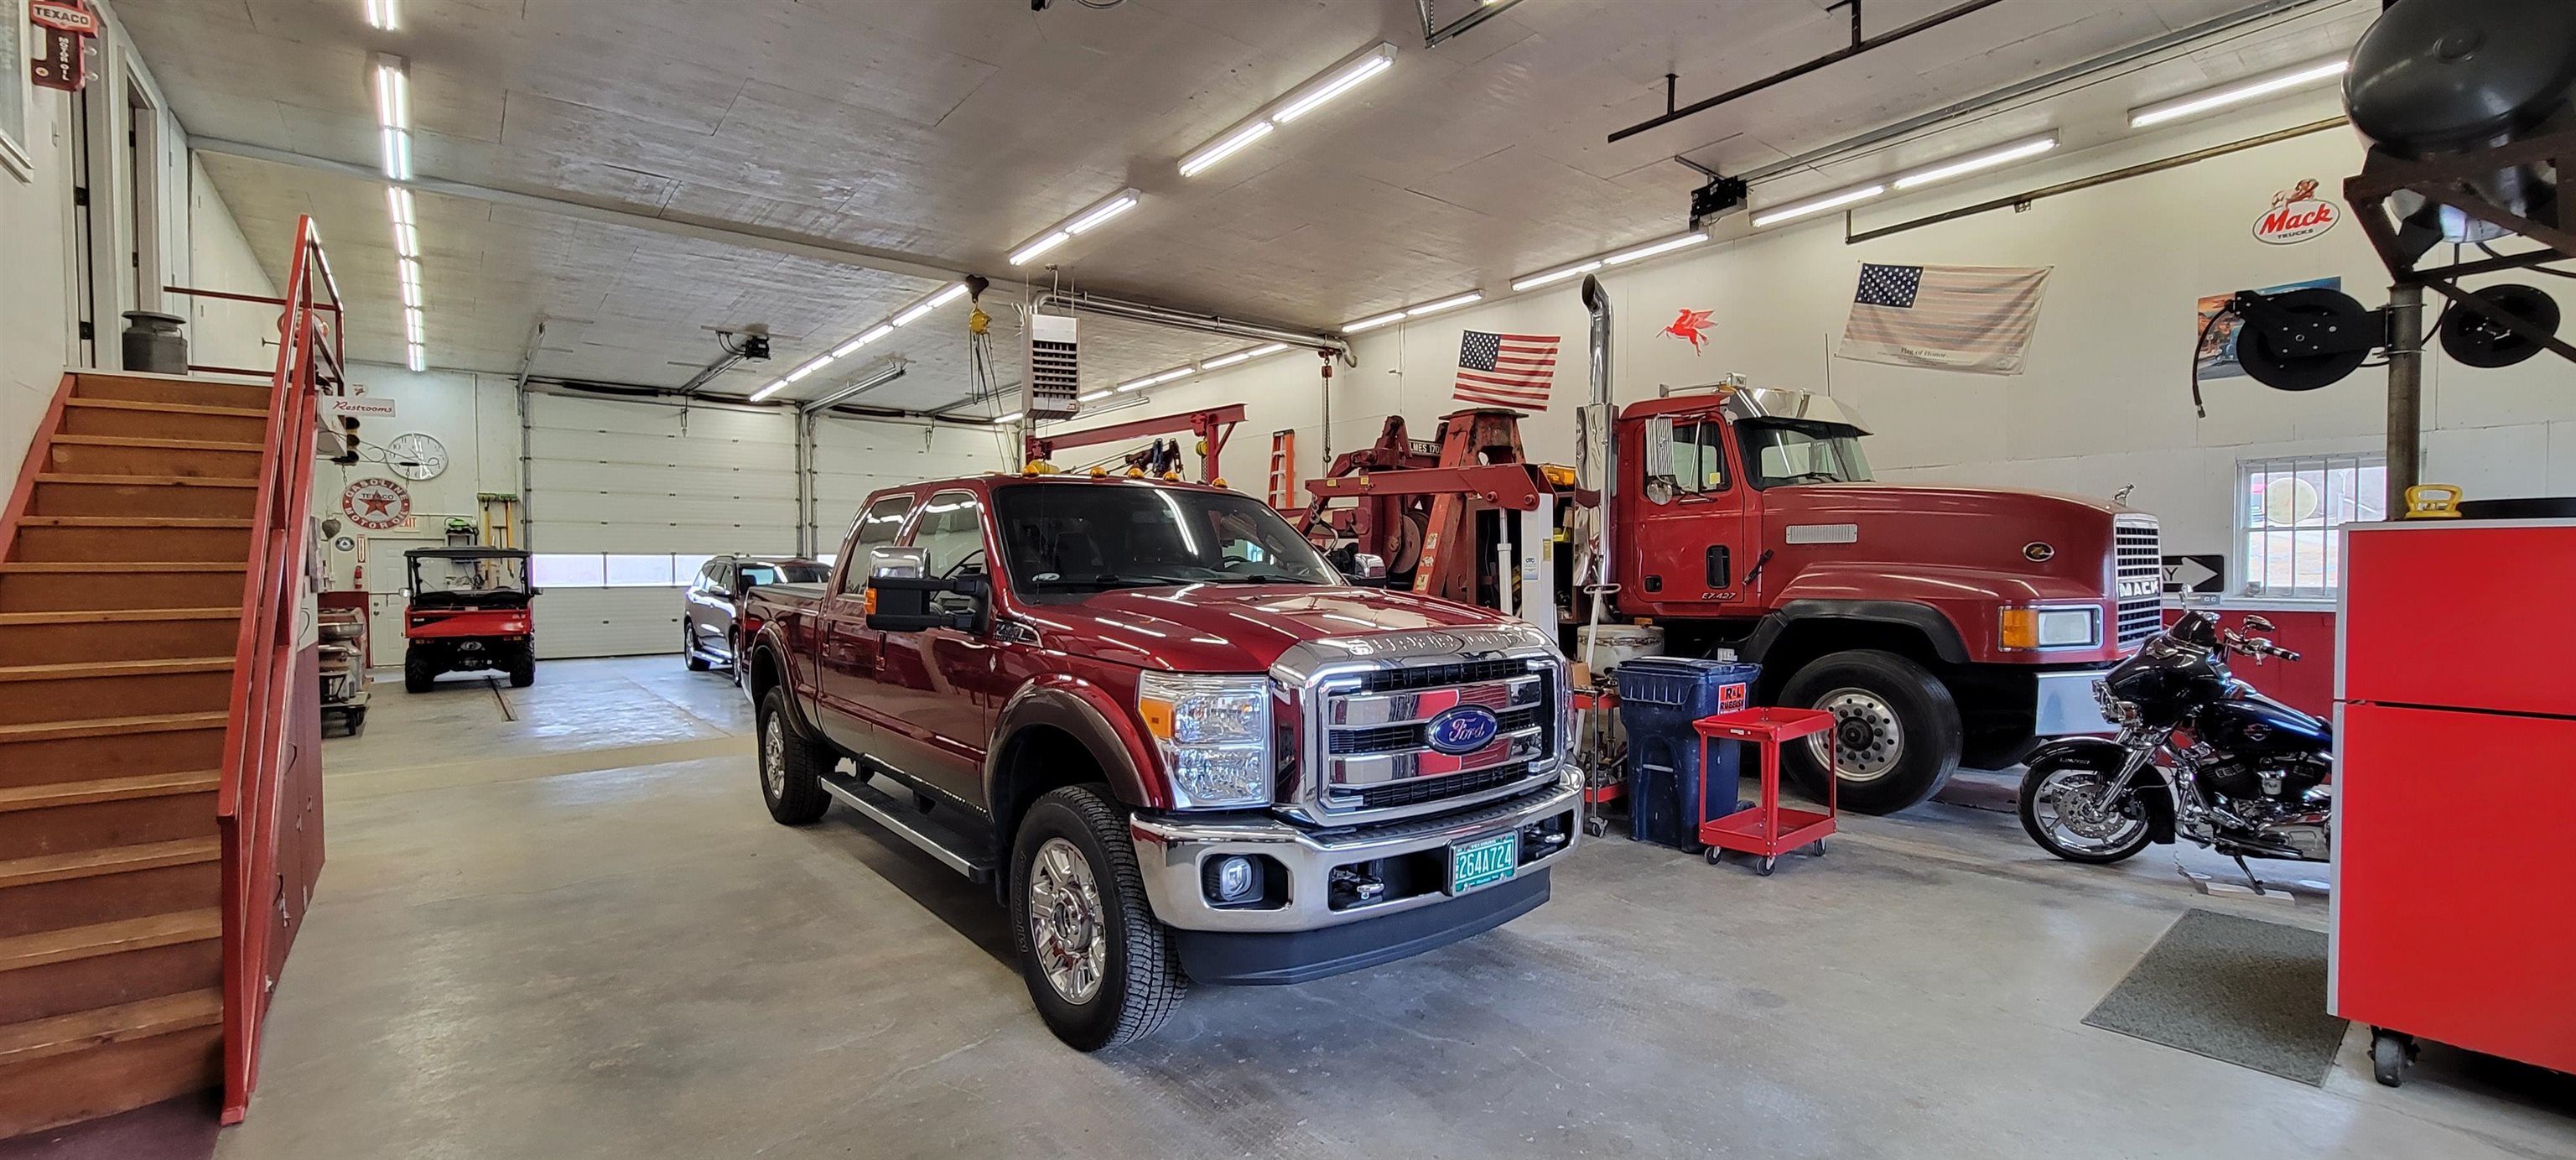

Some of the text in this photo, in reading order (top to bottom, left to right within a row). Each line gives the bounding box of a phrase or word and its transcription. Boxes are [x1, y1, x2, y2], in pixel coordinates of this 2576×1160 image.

[34, 7, 90, 25] TEXACO
[60, 64, 70, 81] OIL
[2259, 203, 2333, 235] Mack
[2277, 228, 2314, 239] TRUCKS
[1901, 346, 1914, 356] Flag
[1924, 350, 1945, 358] Honor
[333, 401, 392, 413] Restrooms
[345, 479, 408, 501] GASOLINE
[345, 507, 388, 529] MOTOR
[392, 510, 408, 524] OIL
[2118, 580, 2159, 598] MACK
[1449, 717, 1485, 742] Ford
[1459, 844, 1512, 880] 264A724
